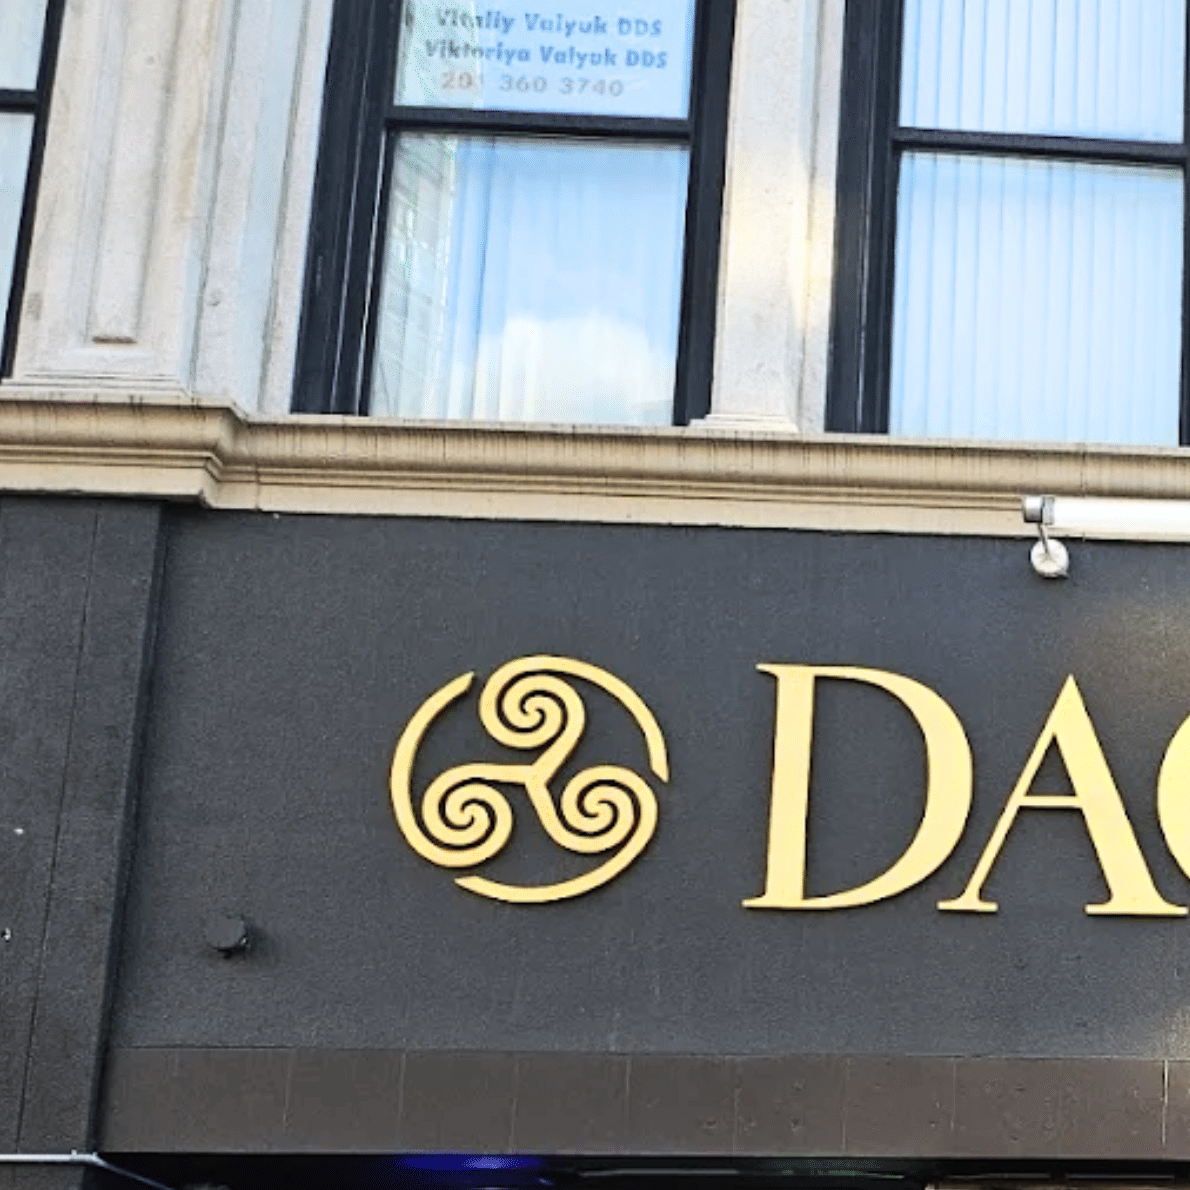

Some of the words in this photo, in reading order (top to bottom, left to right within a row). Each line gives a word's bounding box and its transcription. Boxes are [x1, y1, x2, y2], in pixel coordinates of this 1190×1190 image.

[525, 13, 607, 38] Valyuk
[618, 18, 661, 35] DDS
[540, 45, 616, 69] Valyuk
[626, 50, 667, 68] DDS
[500, 74, 547, 92] 360
[559, 78, 624, 97] 3740
